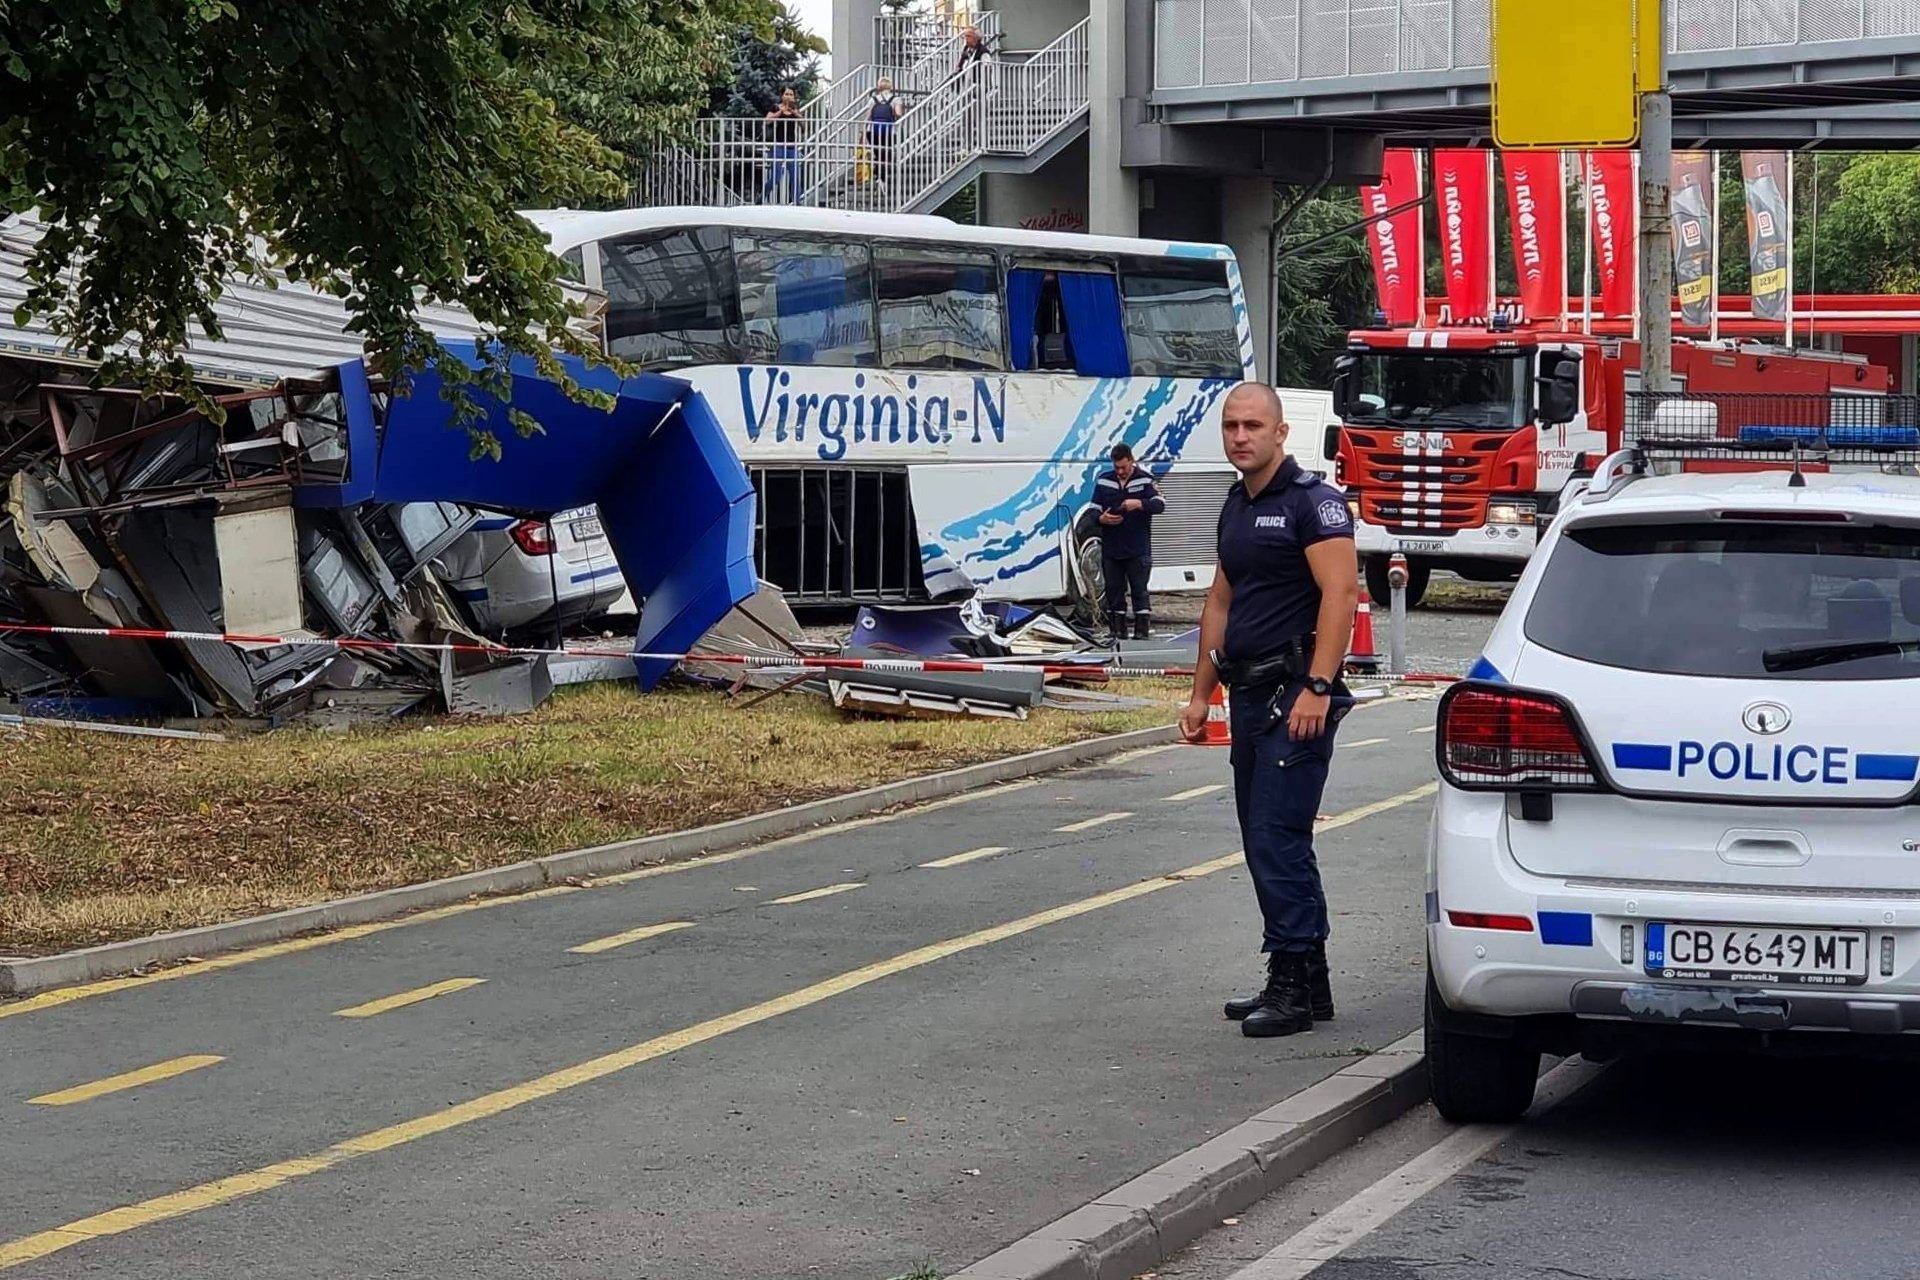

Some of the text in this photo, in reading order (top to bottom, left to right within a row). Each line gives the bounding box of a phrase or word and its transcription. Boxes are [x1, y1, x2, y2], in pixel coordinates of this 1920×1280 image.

[737, 367, 1008, 461] Virginia-N
[1392, 436, 1455, 450] SCANIA
[1255, 516, 1287, 528] POLICE
[1678, 740, 1848, 784] POLICE
[1649, 951, 1663, 961] BG
[1670, 930, 1859, 969] CB 6649 MT
